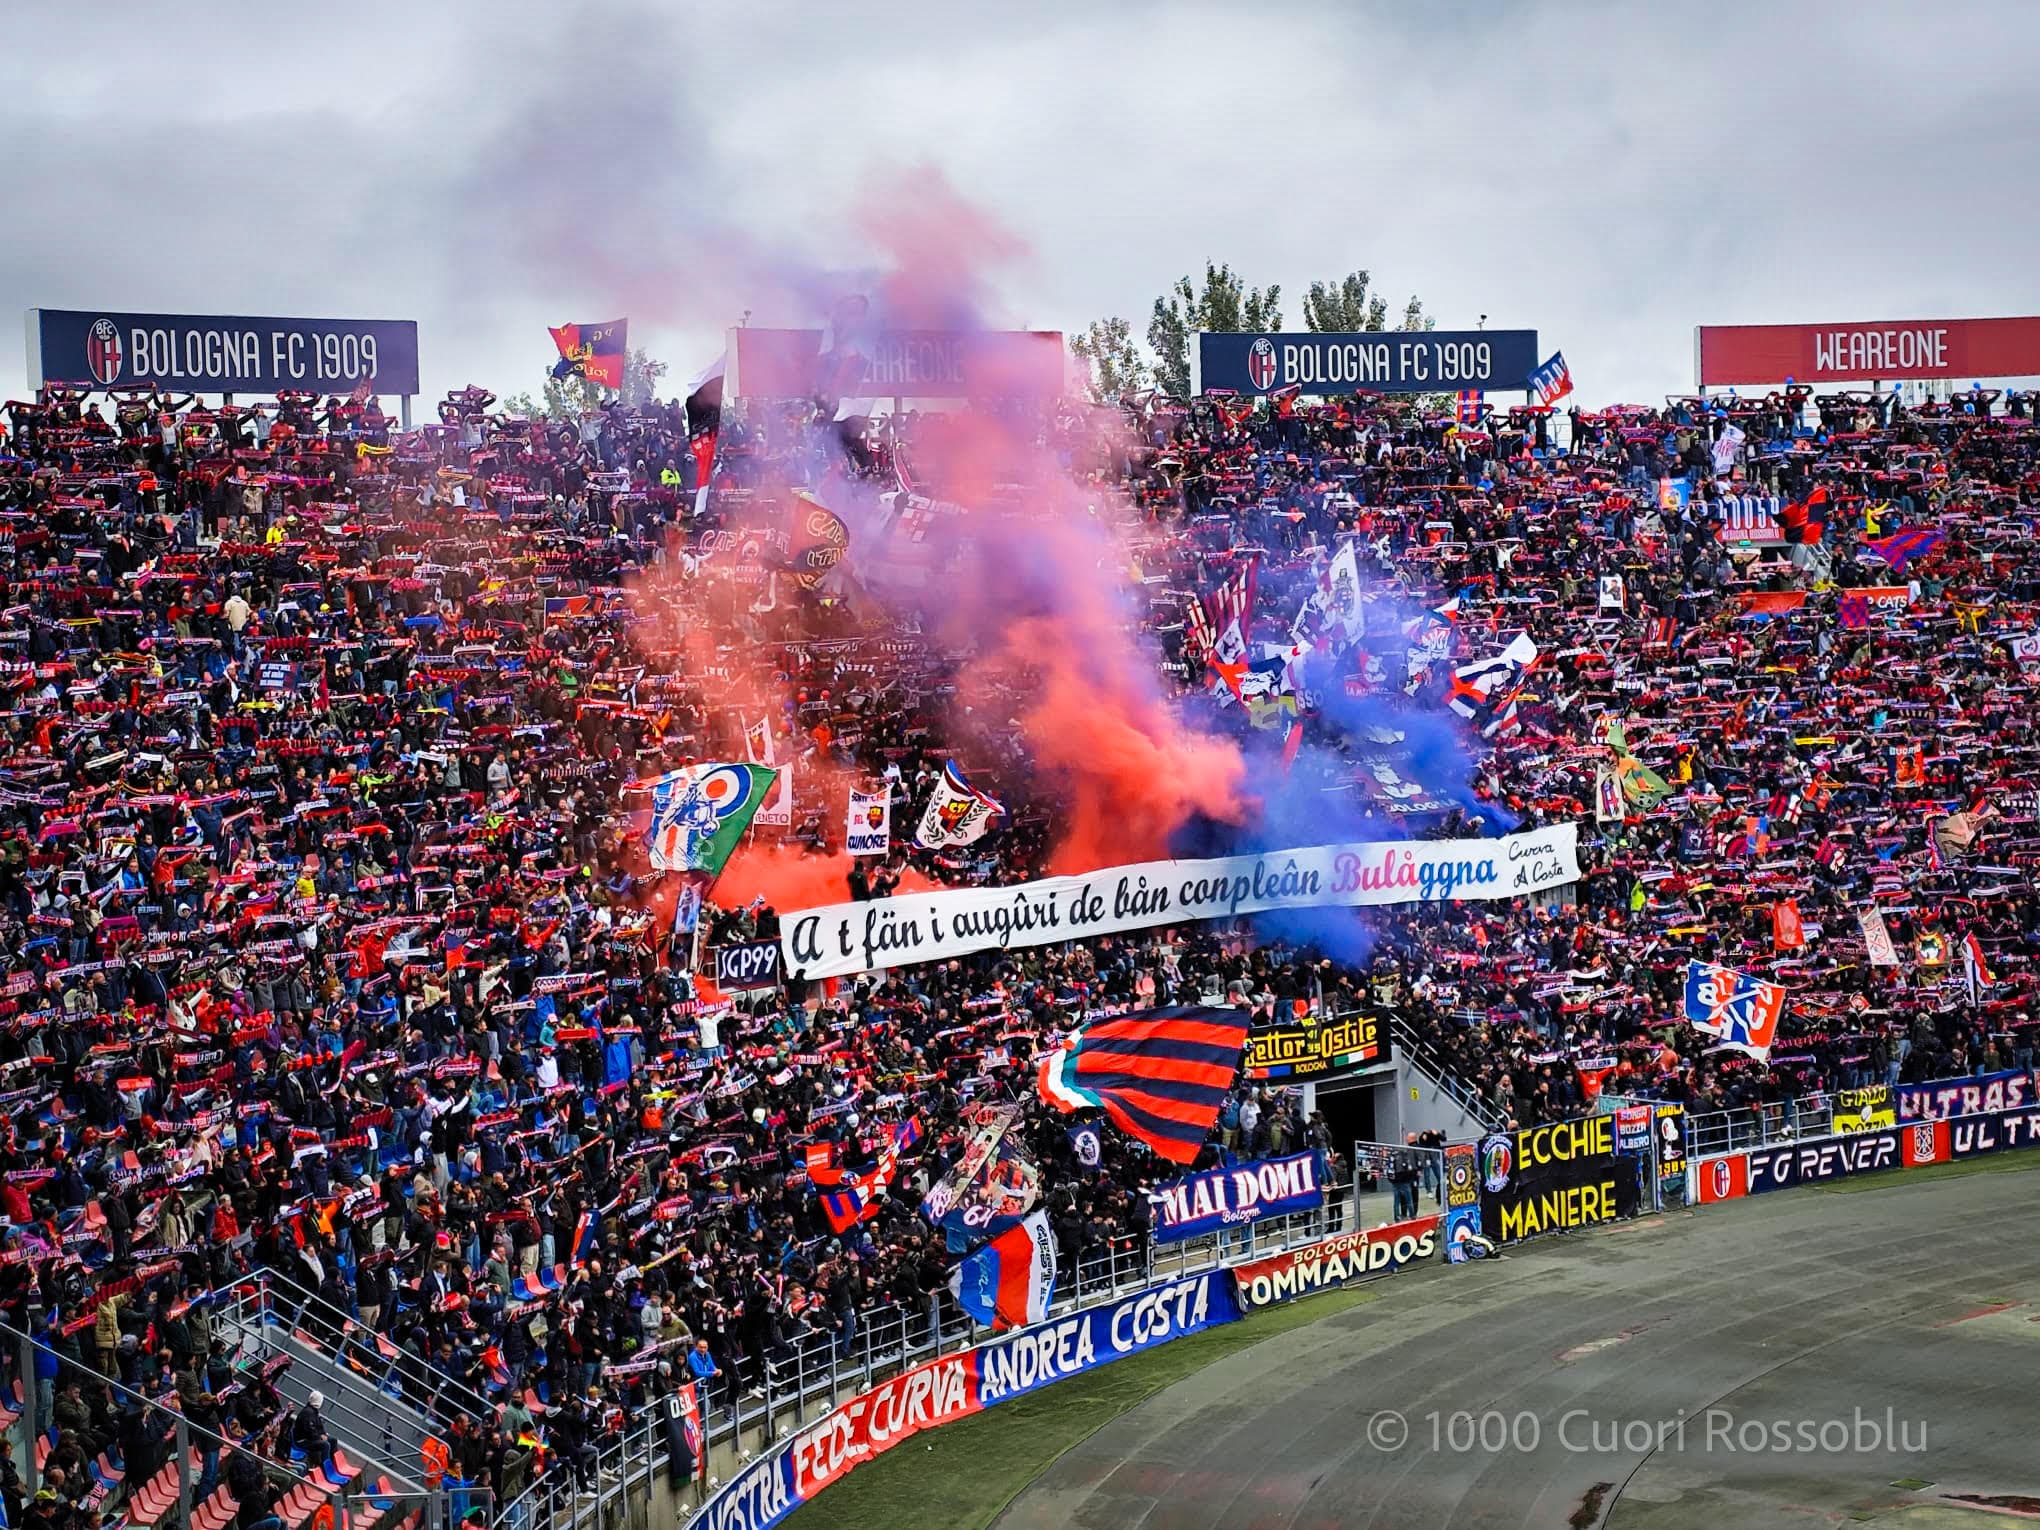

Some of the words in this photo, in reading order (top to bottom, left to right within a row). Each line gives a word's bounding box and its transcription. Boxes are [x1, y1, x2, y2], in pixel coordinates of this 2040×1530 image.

[131, 328, 261, 378] BOLOGNA
[272, 331, 306, 379] FC
[312, 332, 378, 379] 1909
[1284, 344, 1391, 383] BOLOGNA
[1400, 343, 1434, 381] FC
[1434, 343, 1491, 381] 1909
[1816, 329, 1948, 371] WEAREONE
[1877, 595, 1907, 609] CATS
[848, 834, 888, 849] RUMORE
[1508, 841, 1555, 862] Curva
[1532, 857, 1564, 883] Costa
[791, 915, 824, 964] A
[838, 919, 853, 957] t
[862, 907, 924, 969] fän
[930, 907, 944, 943] i
[953, 892, 1061, 947] augûri
[1069, 883, 1106, 927] de
[1114, 875, 1171, 919] bån
[1179, 859, 1322, 915] conpleân
[1331, 848, 1498, 900] Bulåggna
[1244, 1031, 1306, 1068] Settor
[1321, 1017, 1378, 1058] Ostile
[1295, 1060, 1328, 1074] BOLOGNA
[1840, 1087, 1887, 1108] GIALLO
[1900, 1076, 2028, 1120] ULTRAS
[1518, 1115, 1613, 1170] ECCHIE
[1749, 1135, 1897, 1191] FOREVER
[1161, 1176, 1229, 1226] MAI
[1232, 1156, 1317, 1209] DOMI
[1500, 1180, 1616, 1242] MANIERE
[1294, 1233, 1369, 1265] BOLOGNA
[793, 1404, 869, 1497] FEDE
[869, 1357, 968, 1442] CURVA
[980, 1315, 1096, 1400] ANDREA
[1110, 1276, 1209, 1353] COSTA
